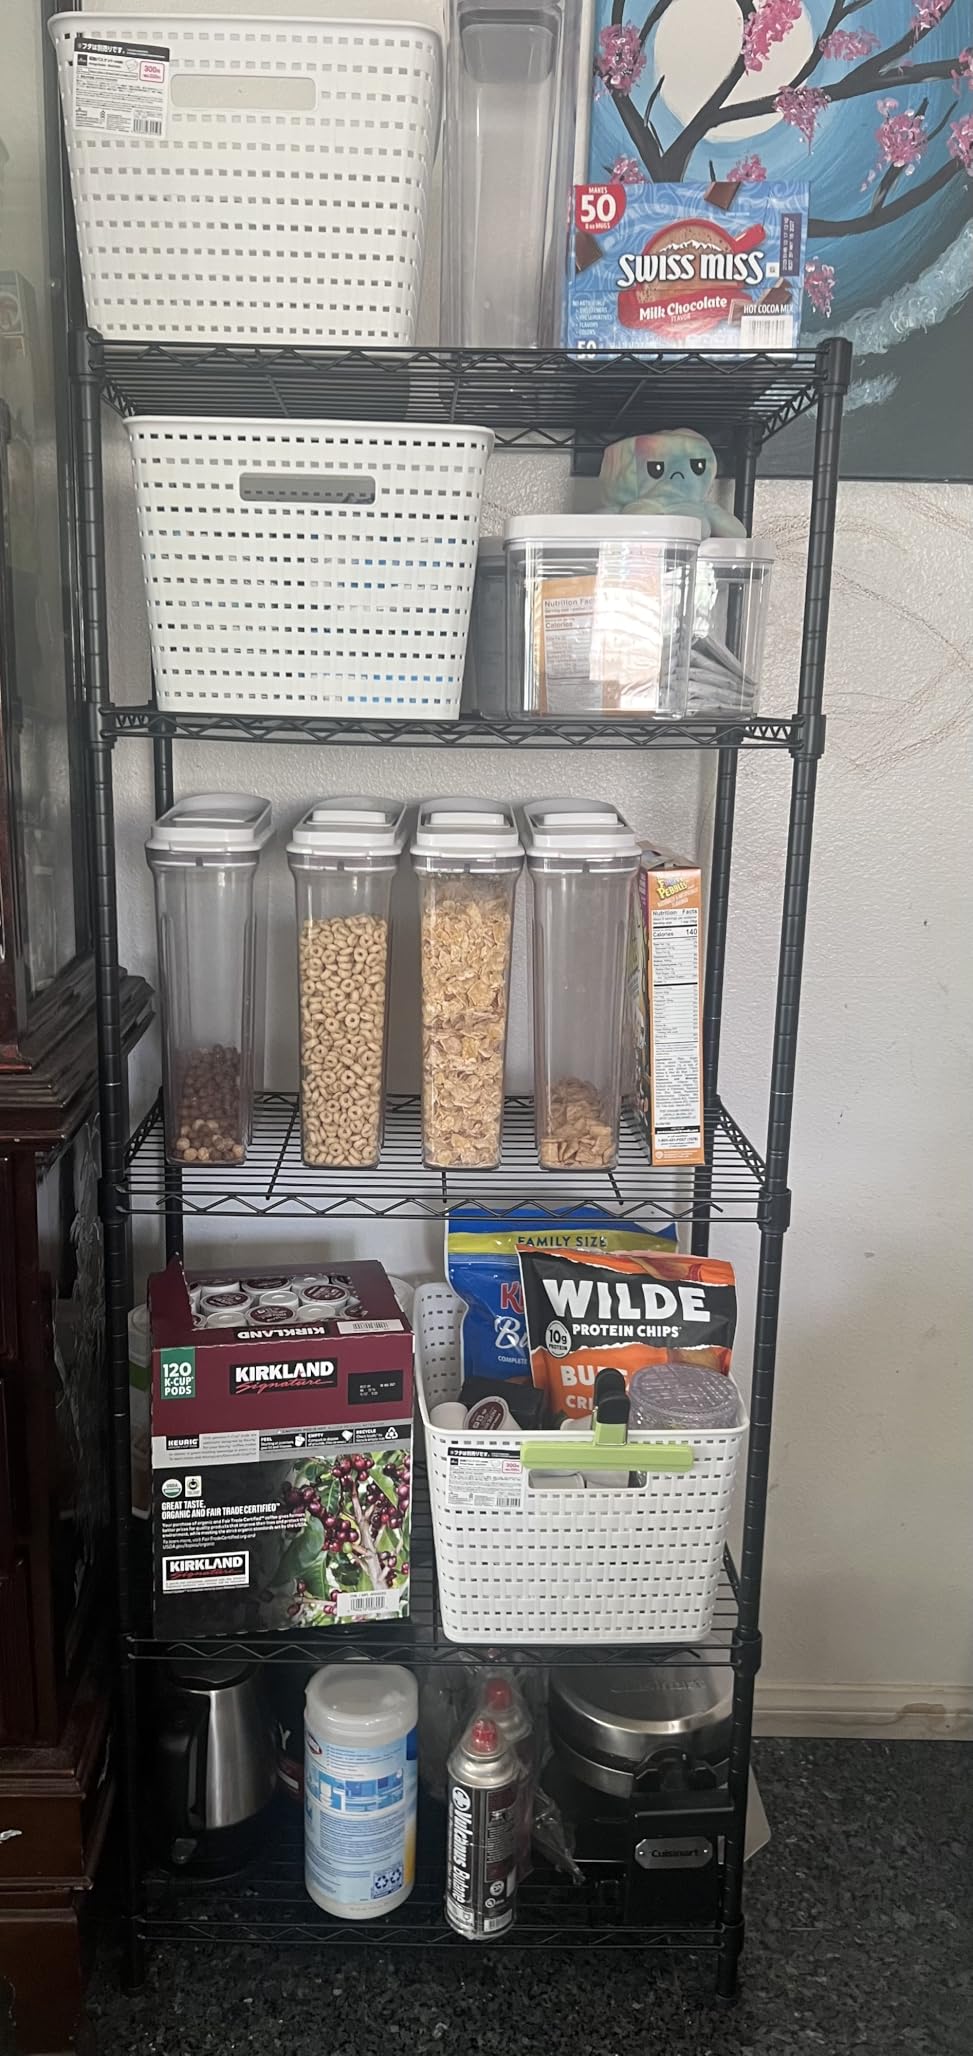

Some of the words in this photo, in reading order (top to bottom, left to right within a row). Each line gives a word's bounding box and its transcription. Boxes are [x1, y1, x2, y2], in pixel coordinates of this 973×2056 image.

[580, 195, 616, 223] 50
[616, 253, 695, 287] SWISS
[639, 305, 666, 321] Milk
[667, 296, 727, 315] Chocolate
[743, 304, 757, 313] HOT
[758, 304, 779, 313] COCOA
[671, 314, 691, 322] FLAVOR
[544, 599, 578, 607] Nutrition
[518, 1236, 571, 1247] FAMILY
[576, 1236, 608, 1247] SIZE
[542, 1279, 711, 1322] WILDE
[237, 1327, 325, 1339] KIRKLAND
[550, 1329, 568, 1344] 10g
[572, 1323, 634, 1337] PROTEIN
[636, 1325, 679, 1337] CHIPS
[162, 1361, 192, 1377] 120
[235, 1361, 334, 1382] KIRKLAND
[164, 1386, 192, 1396] PODS
[235, 1379, 334, 1394] Signature
[168, 1438, 198, 1446] KEURIG
[161, 1501, 183, 1510] GREAT
[184, 1500, 206, 1509] TASTE.
[161, 1510, 190, 1520] ORGANIC
[191, 1508, 206, 1517] AND
[206, 1507, 222, 1517] FAIR
[222, 1506, 243, 1516] TRADE
[169, 1556, 243, 1573] KIRKLAND
[170, 1569, 243, 1579] Signature
[453, 1809, 473, 1867] Vulcanus
[452, 1865, 471, 1903] Butane
